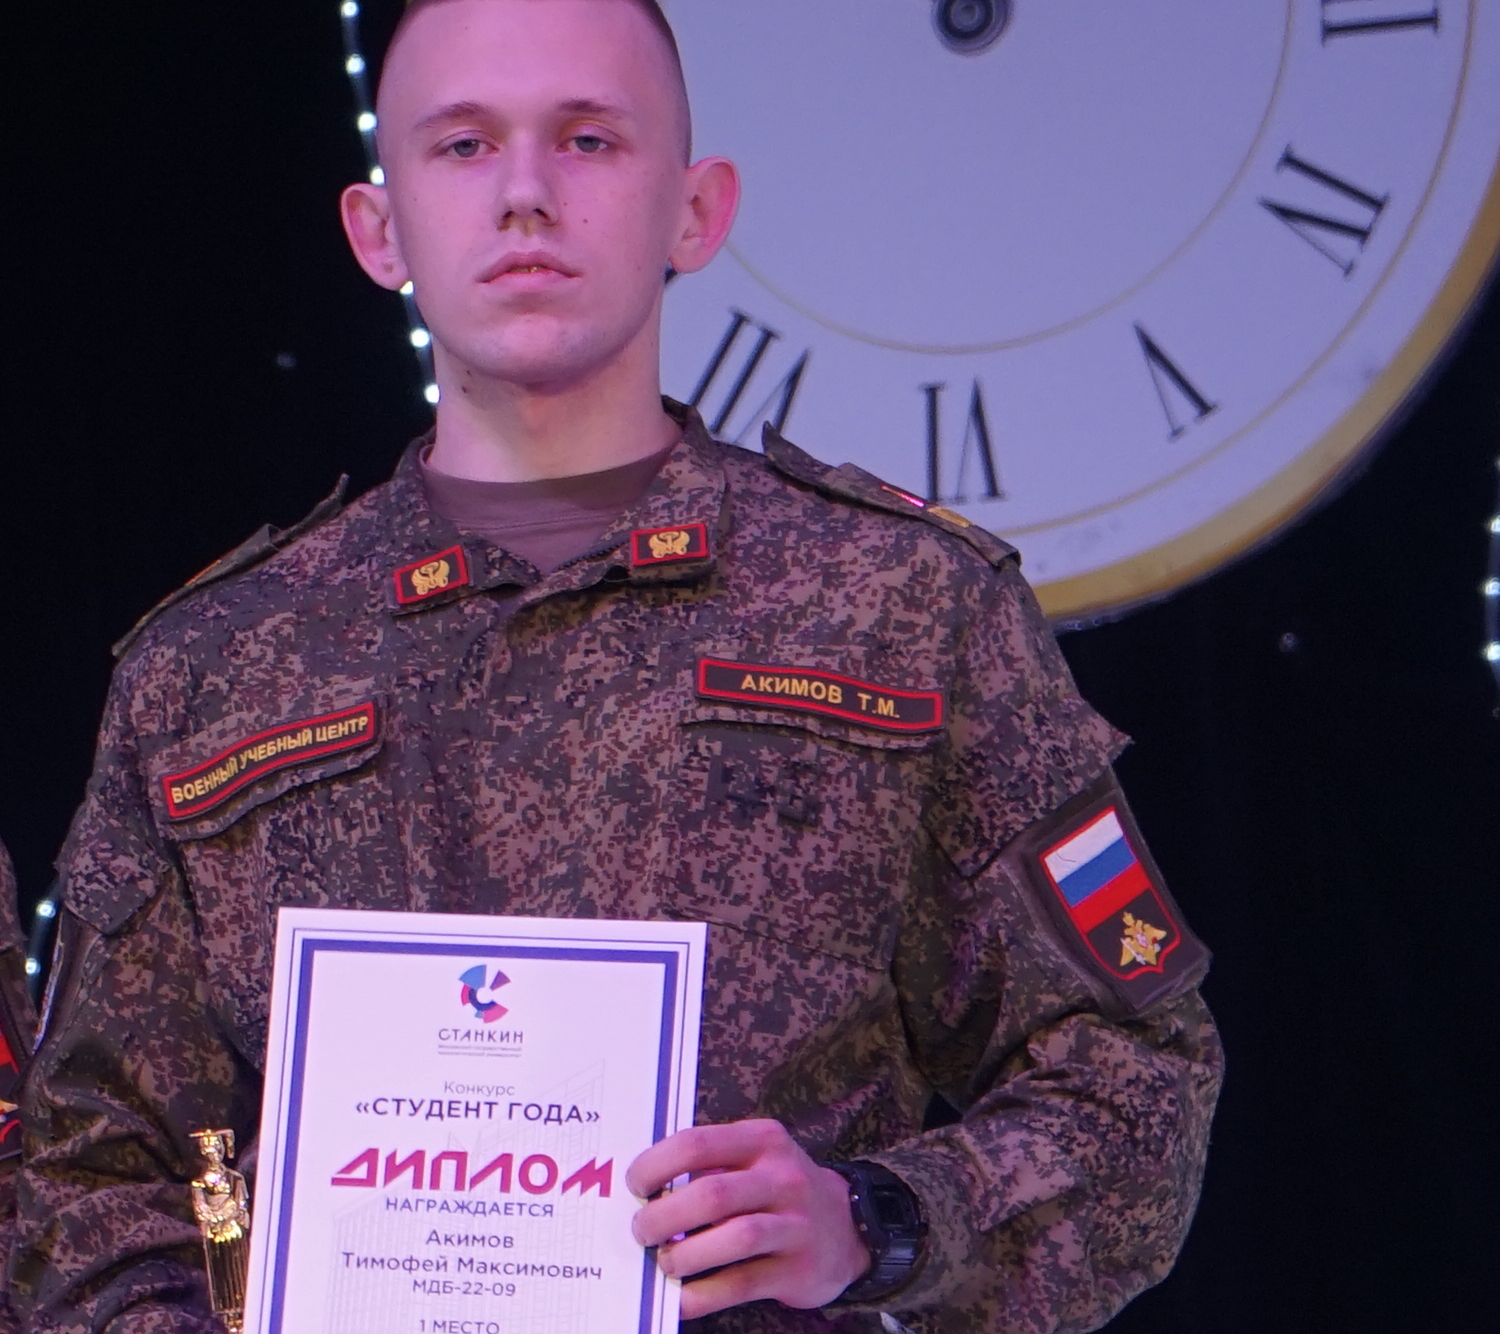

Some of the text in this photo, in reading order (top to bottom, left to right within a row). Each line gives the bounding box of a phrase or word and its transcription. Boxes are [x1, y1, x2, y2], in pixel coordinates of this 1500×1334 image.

[1258, 144, 1391, 278] IV
[1134, 318, 1219, 443] V
[919, 376, 1005, 504] VI
[741, 674, 900, 719] АКИМОВ Т.М.
[171, 716, 368, 804] ВОЕННЫЙ УЧЕБНЫЙ ЦЕНТР
[438, 1028, 524, 1043] СТАНКИН
[444, 1081, 515, 1097] Конкурс
[356, 1097, 600, 1125] «СТУДЕНТ ГОДА»
[330, 1147, 614, 1199] ДИПЛОМ
[385, 1197, 553, 1218] НАГРАЖДАЕТСЯ
[425, 1230, 514, 1249] Акимов
[342, 1252, 602, 1281] Тимофей Максимович
[412, 1279, 516, 1299] МДБ-22-09
[419, 1320, 428, 1334] 1
